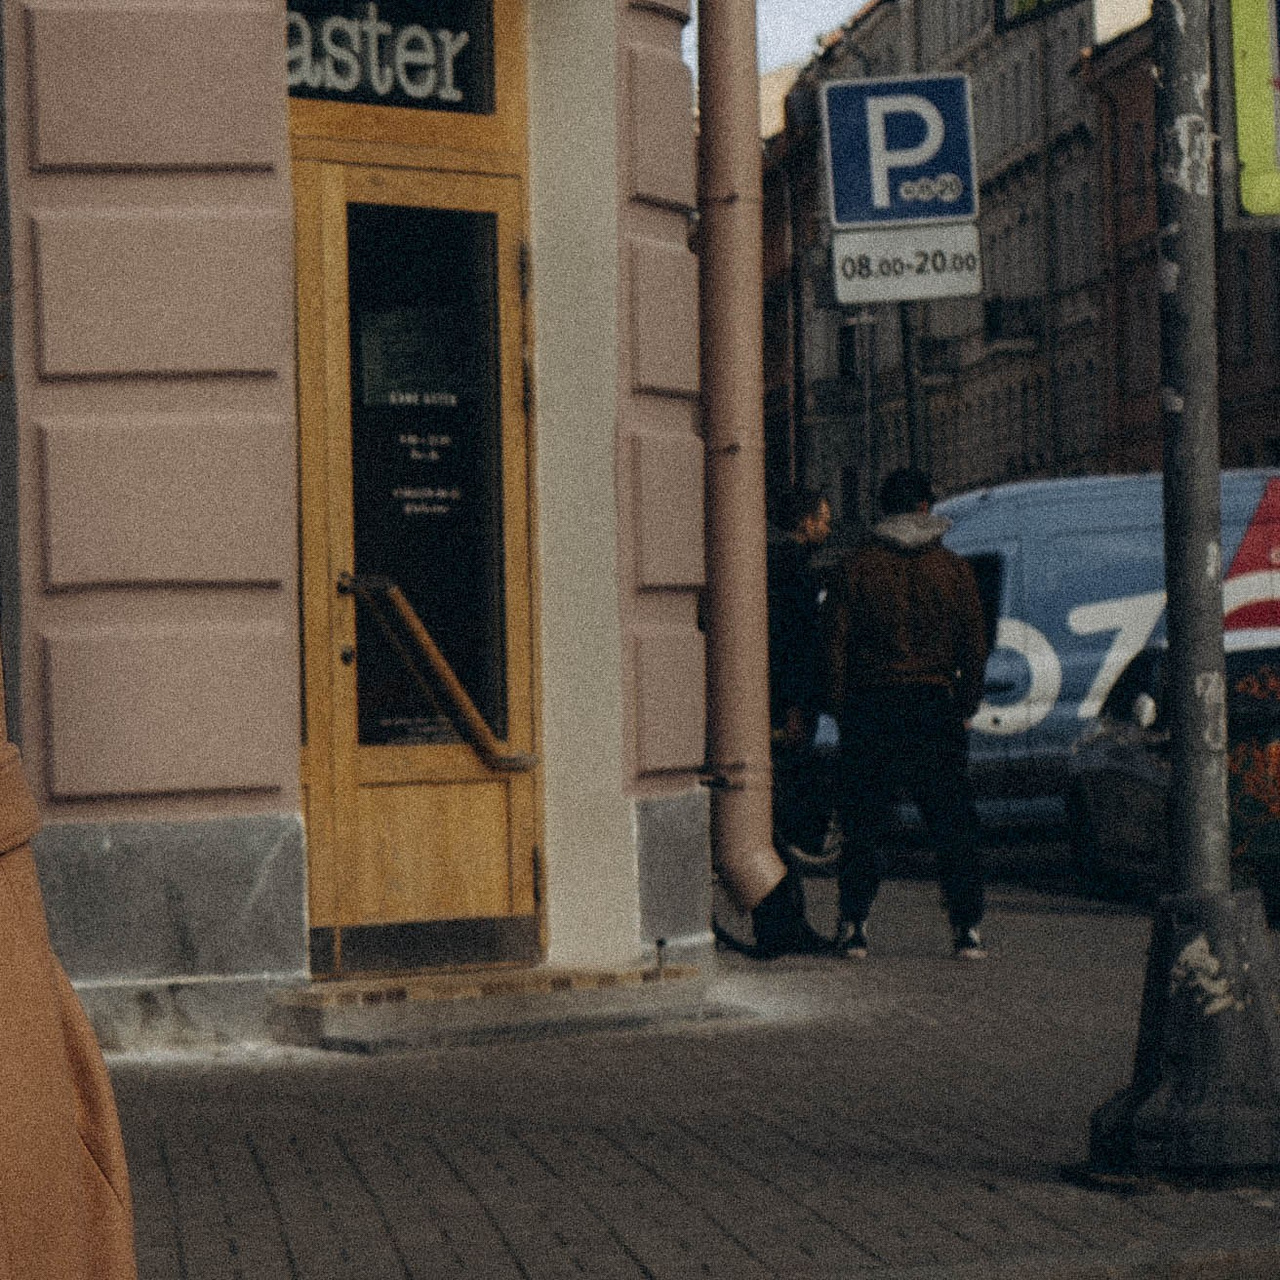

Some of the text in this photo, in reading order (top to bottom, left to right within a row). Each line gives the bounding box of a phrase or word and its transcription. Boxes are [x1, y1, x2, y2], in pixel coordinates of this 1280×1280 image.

[287, 3, 468, 102] aster
[866, 95, 945, 208] P
[842, 251, 977, 279] 08.00-20.00
